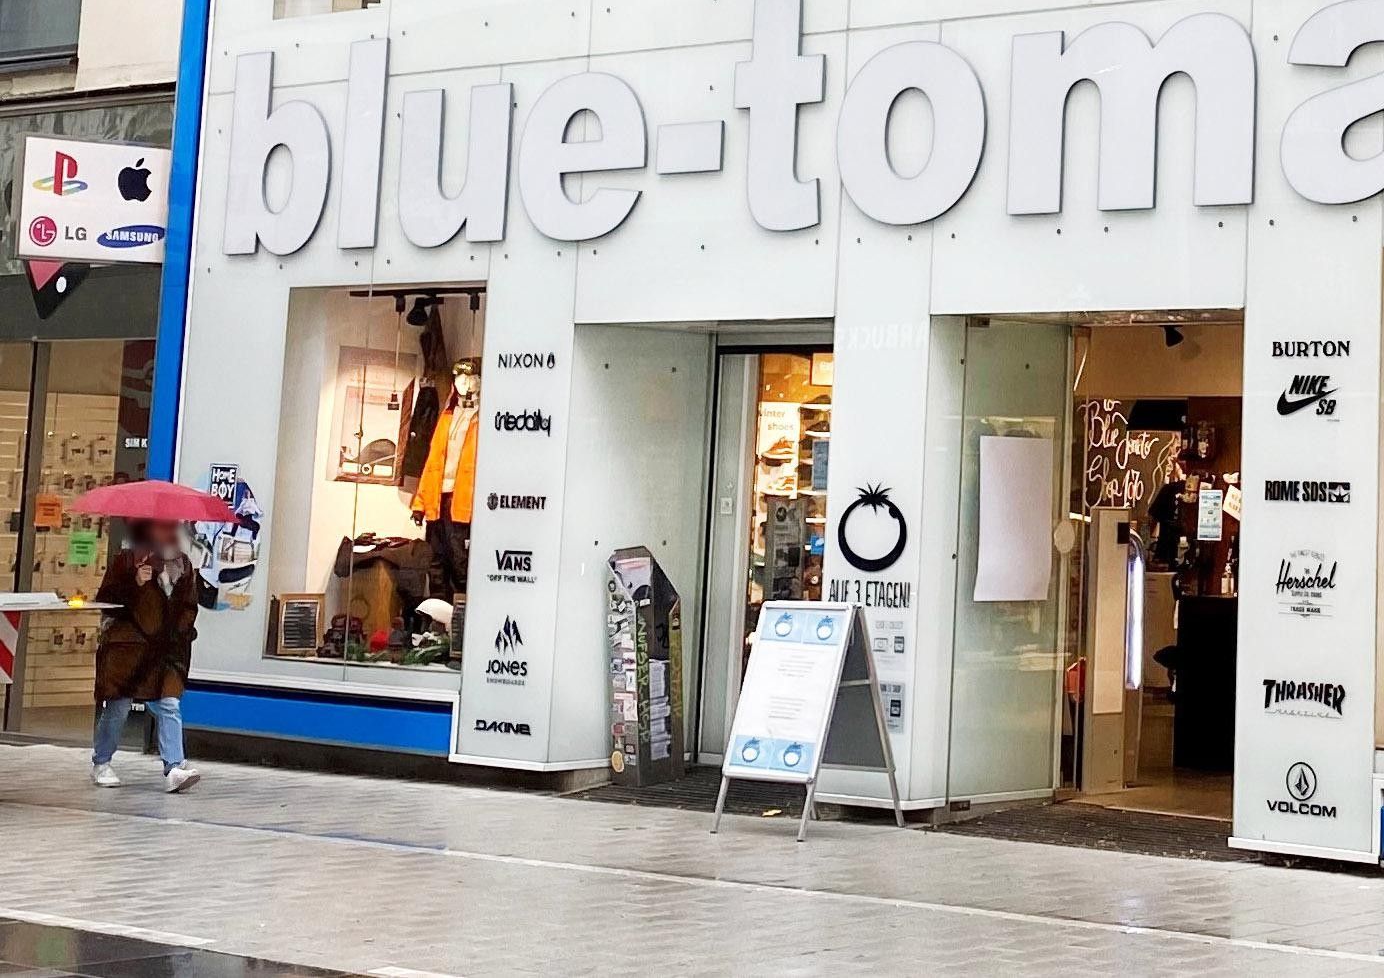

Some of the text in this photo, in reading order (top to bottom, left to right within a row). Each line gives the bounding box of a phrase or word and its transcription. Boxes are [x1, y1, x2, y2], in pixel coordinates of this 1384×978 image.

[64, 225, 87, 241] LG
[105, 229, 159, 243] SAMSUNG
[1271, 340, 1351, 357] BURTON
[497, 353, 544, 369] NIXON
[1288, 375, 1330, 396] NIKE
[1315, 398, 1337, 416] SB
[1264, 480, 1300, 502] ROME
[499, 495, 547, 510] ELEMENT
[495, 549, 533, 571] VANS
[1275, 558, 1337, 594] Herschel
[865, 580, 912, 609] ETAGEN!
[1262, 679, 1346, 716] THRASHER
[474, 719, 532, 736] DAKINE
[1266, 799, 1338, 819] VOLCOM
